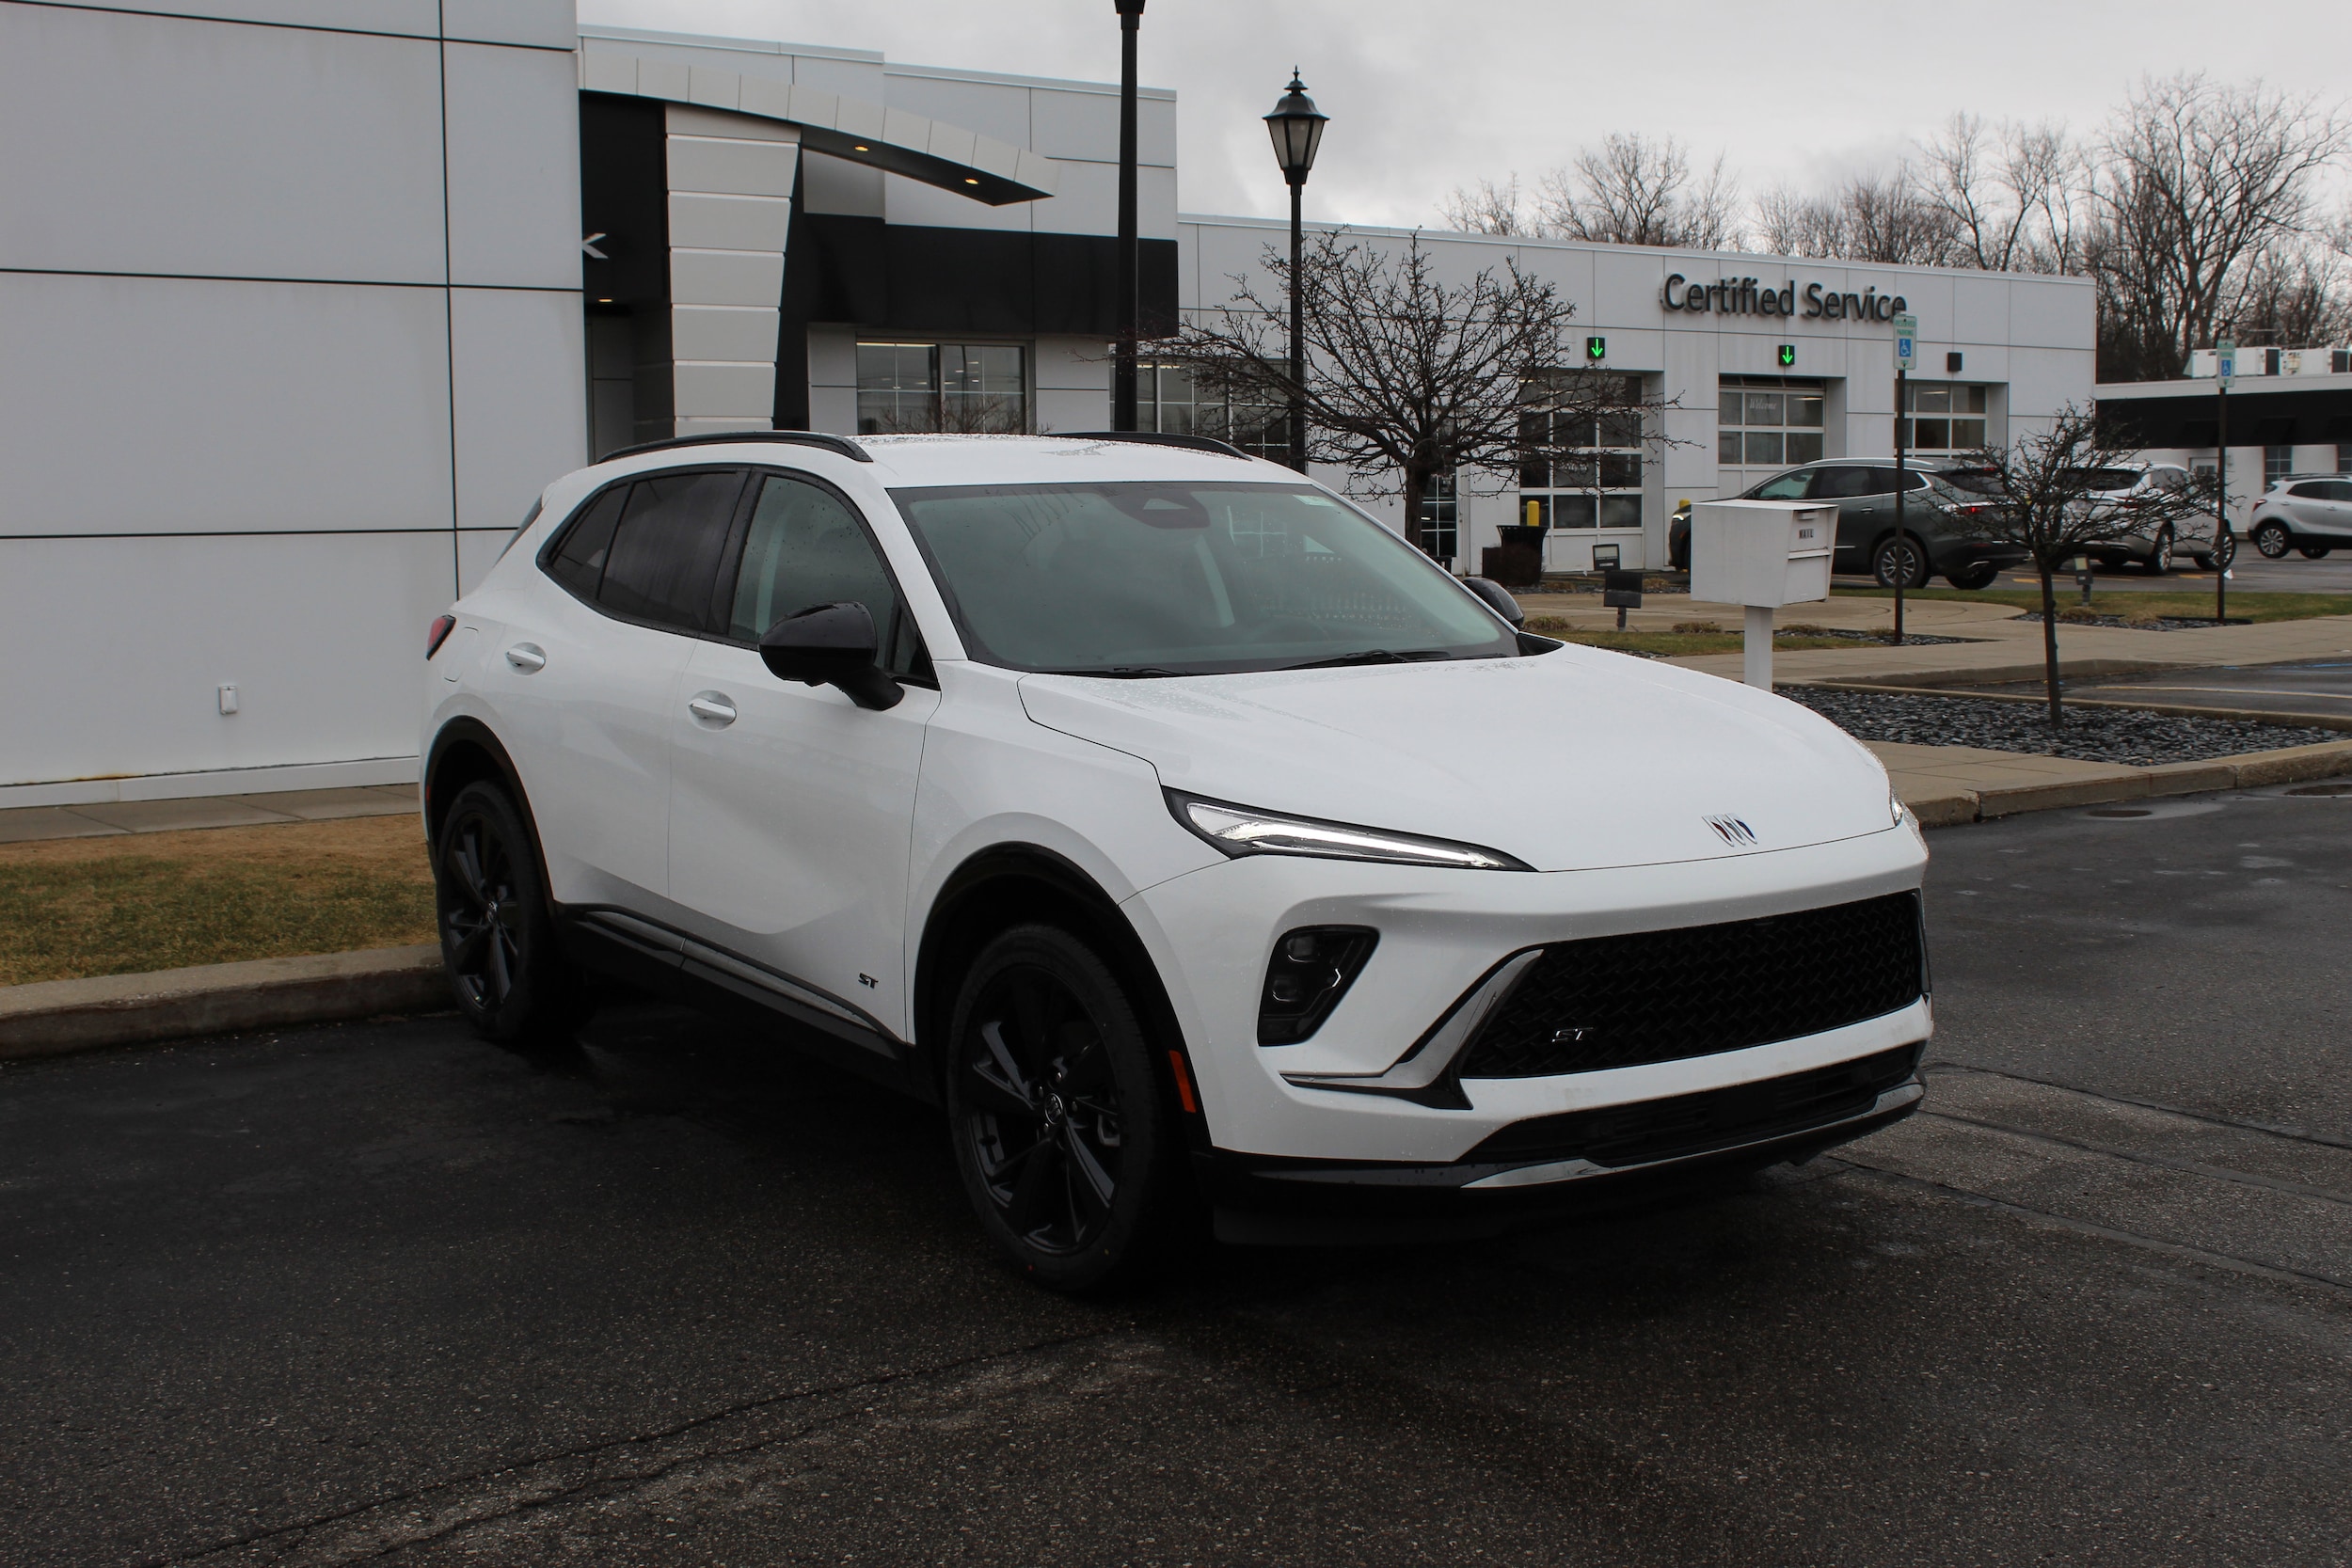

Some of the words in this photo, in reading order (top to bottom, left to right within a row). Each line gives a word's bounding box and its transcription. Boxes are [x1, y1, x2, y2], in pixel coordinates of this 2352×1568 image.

[1663, 273, 1795, 316] Certified
[1804, 282, 1907, 321] Service
[1750, 398, 1777, 410] Welcome
[1798, 529, 1814, 539] MAIL
[858, 973, 879, 989] ST
